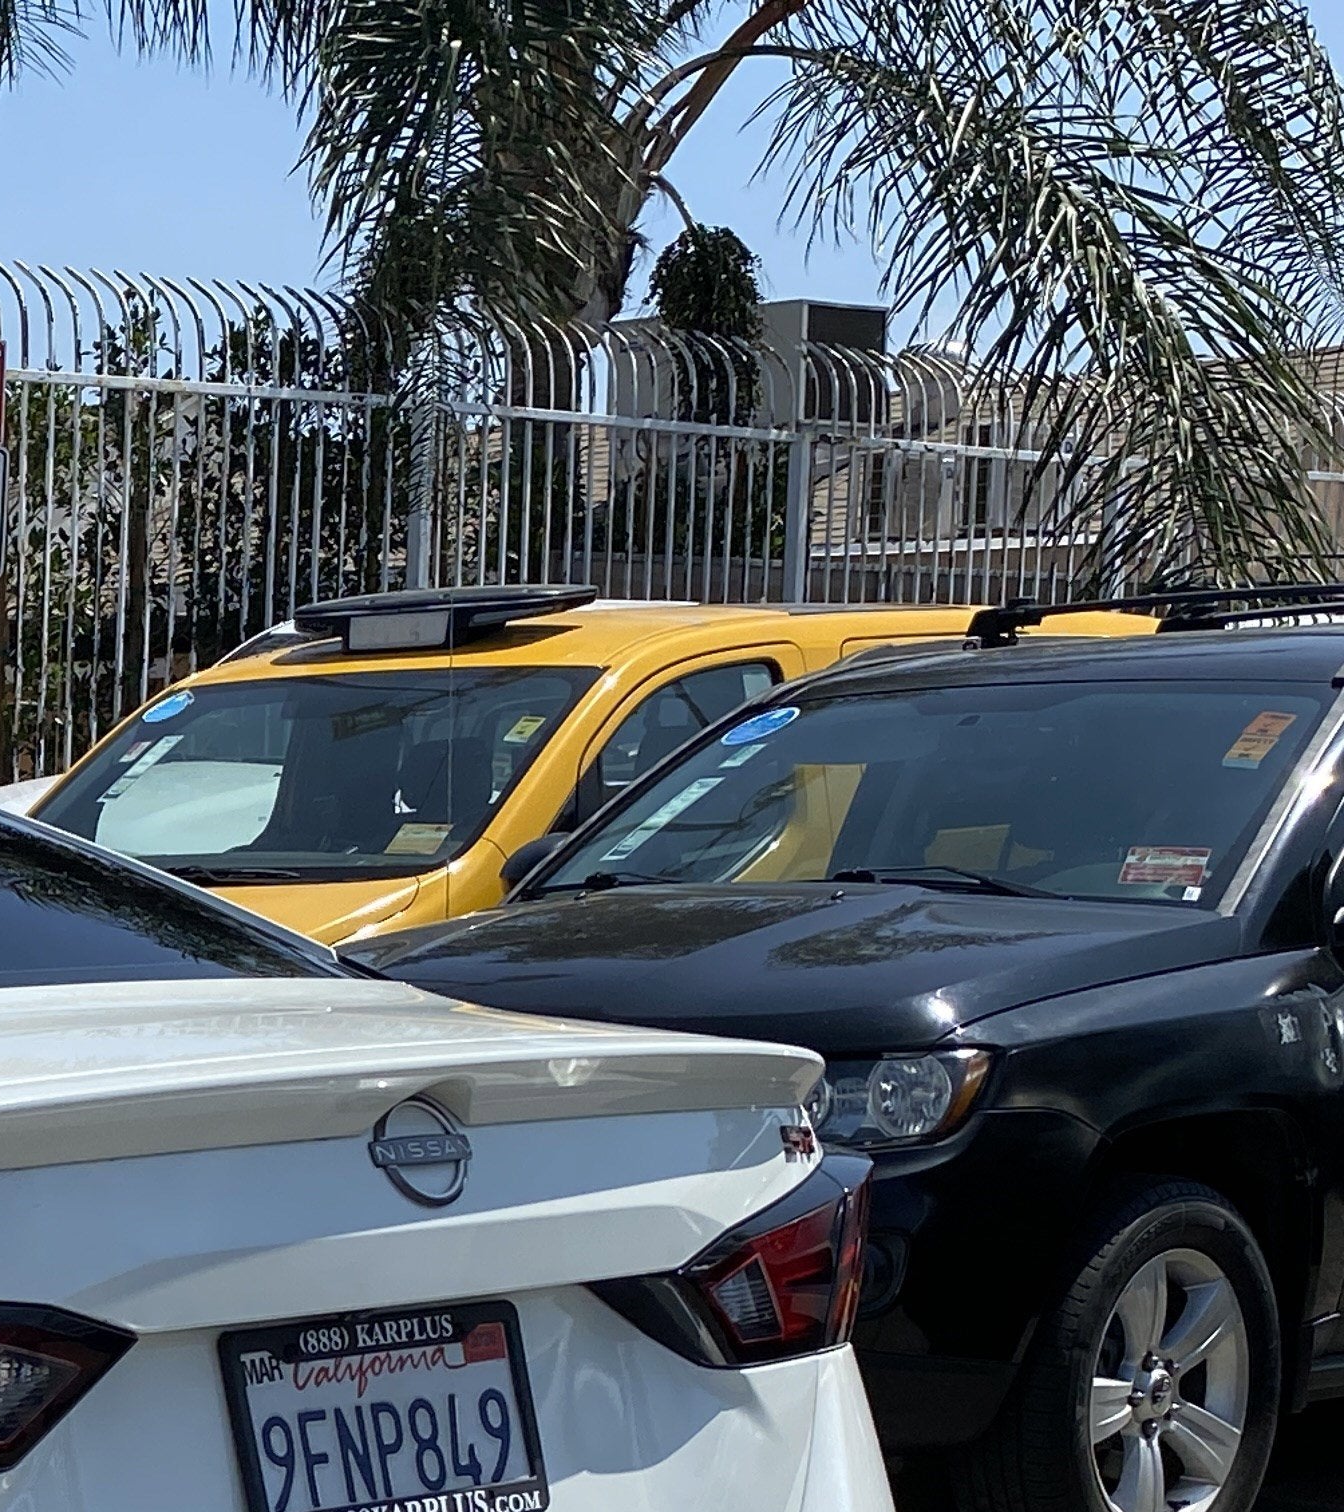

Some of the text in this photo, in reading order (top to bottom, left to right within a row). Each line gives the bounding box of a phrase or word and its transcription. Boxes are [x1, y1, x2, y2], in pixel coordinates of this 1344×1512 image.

[374, 1139, 471, 1162] NISSAN
[298, 1326, 349, 1354] (888)
[357, 1314, 454, 1348] KARPLUS
[241, 1357, 284, 1386] MAR
[292, 1346, 468, 1398] California
